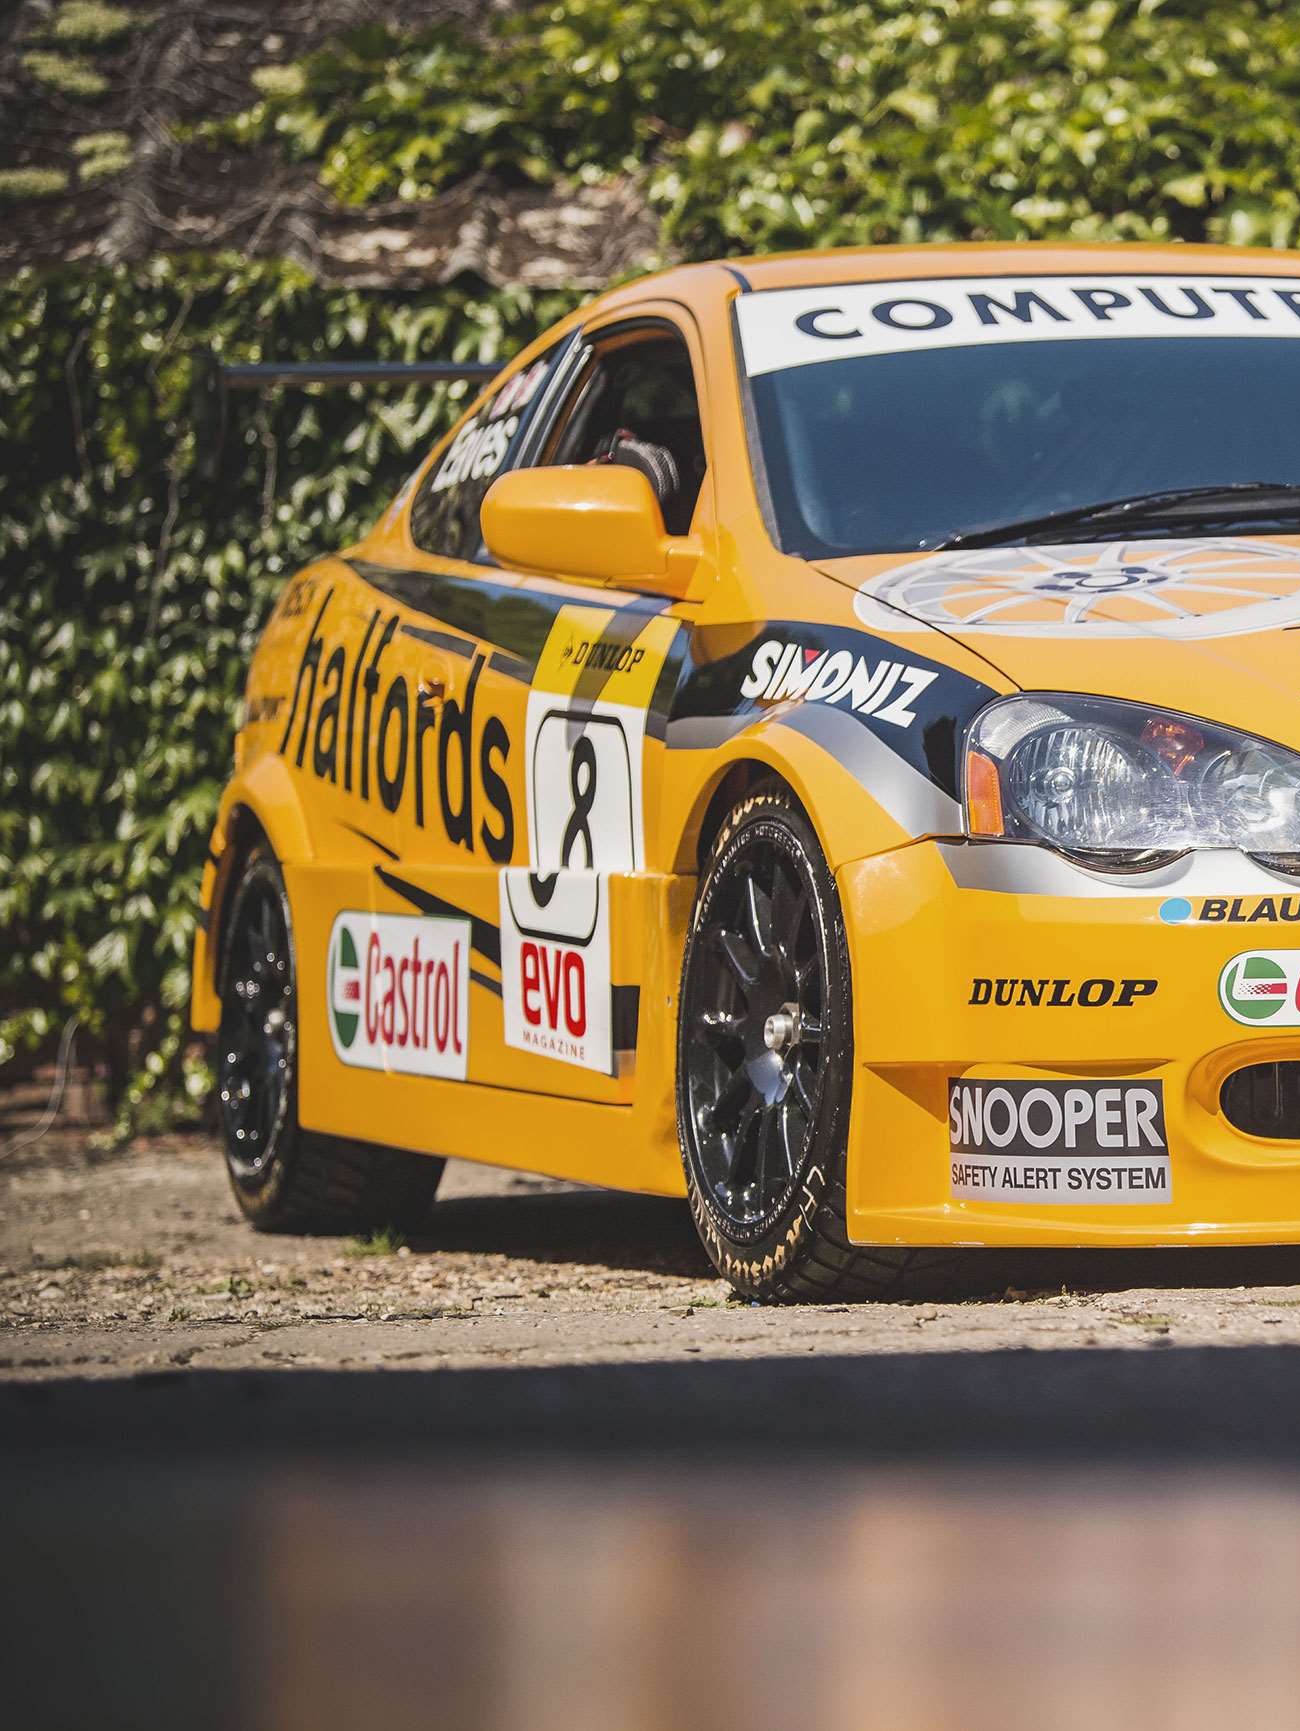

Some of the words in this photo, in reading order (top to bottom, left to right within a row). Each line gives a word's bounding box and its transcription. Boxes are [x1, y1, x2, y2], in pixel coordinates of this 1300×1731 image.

[573, 641, 645, 673] DUNLOP
[740, 641, 940, 728] SIMONIZ
[280, 587, 515, 865] halfords
[365, 931, 464, 1055] Castrol
[520, 941, 588, 1038] evo
[968, 978, 1158, 1007] DUNLOP
[522, 1028, 586, 1062] MAGAZINE
[948, 1086, 1165, 1149] SNOOPER
[951, 1163, 999, 1190] SAFETY
[1002, 1166, 1062, 1191] ALERT
[1067, 1167, 1166, 1191] SYSTEM
